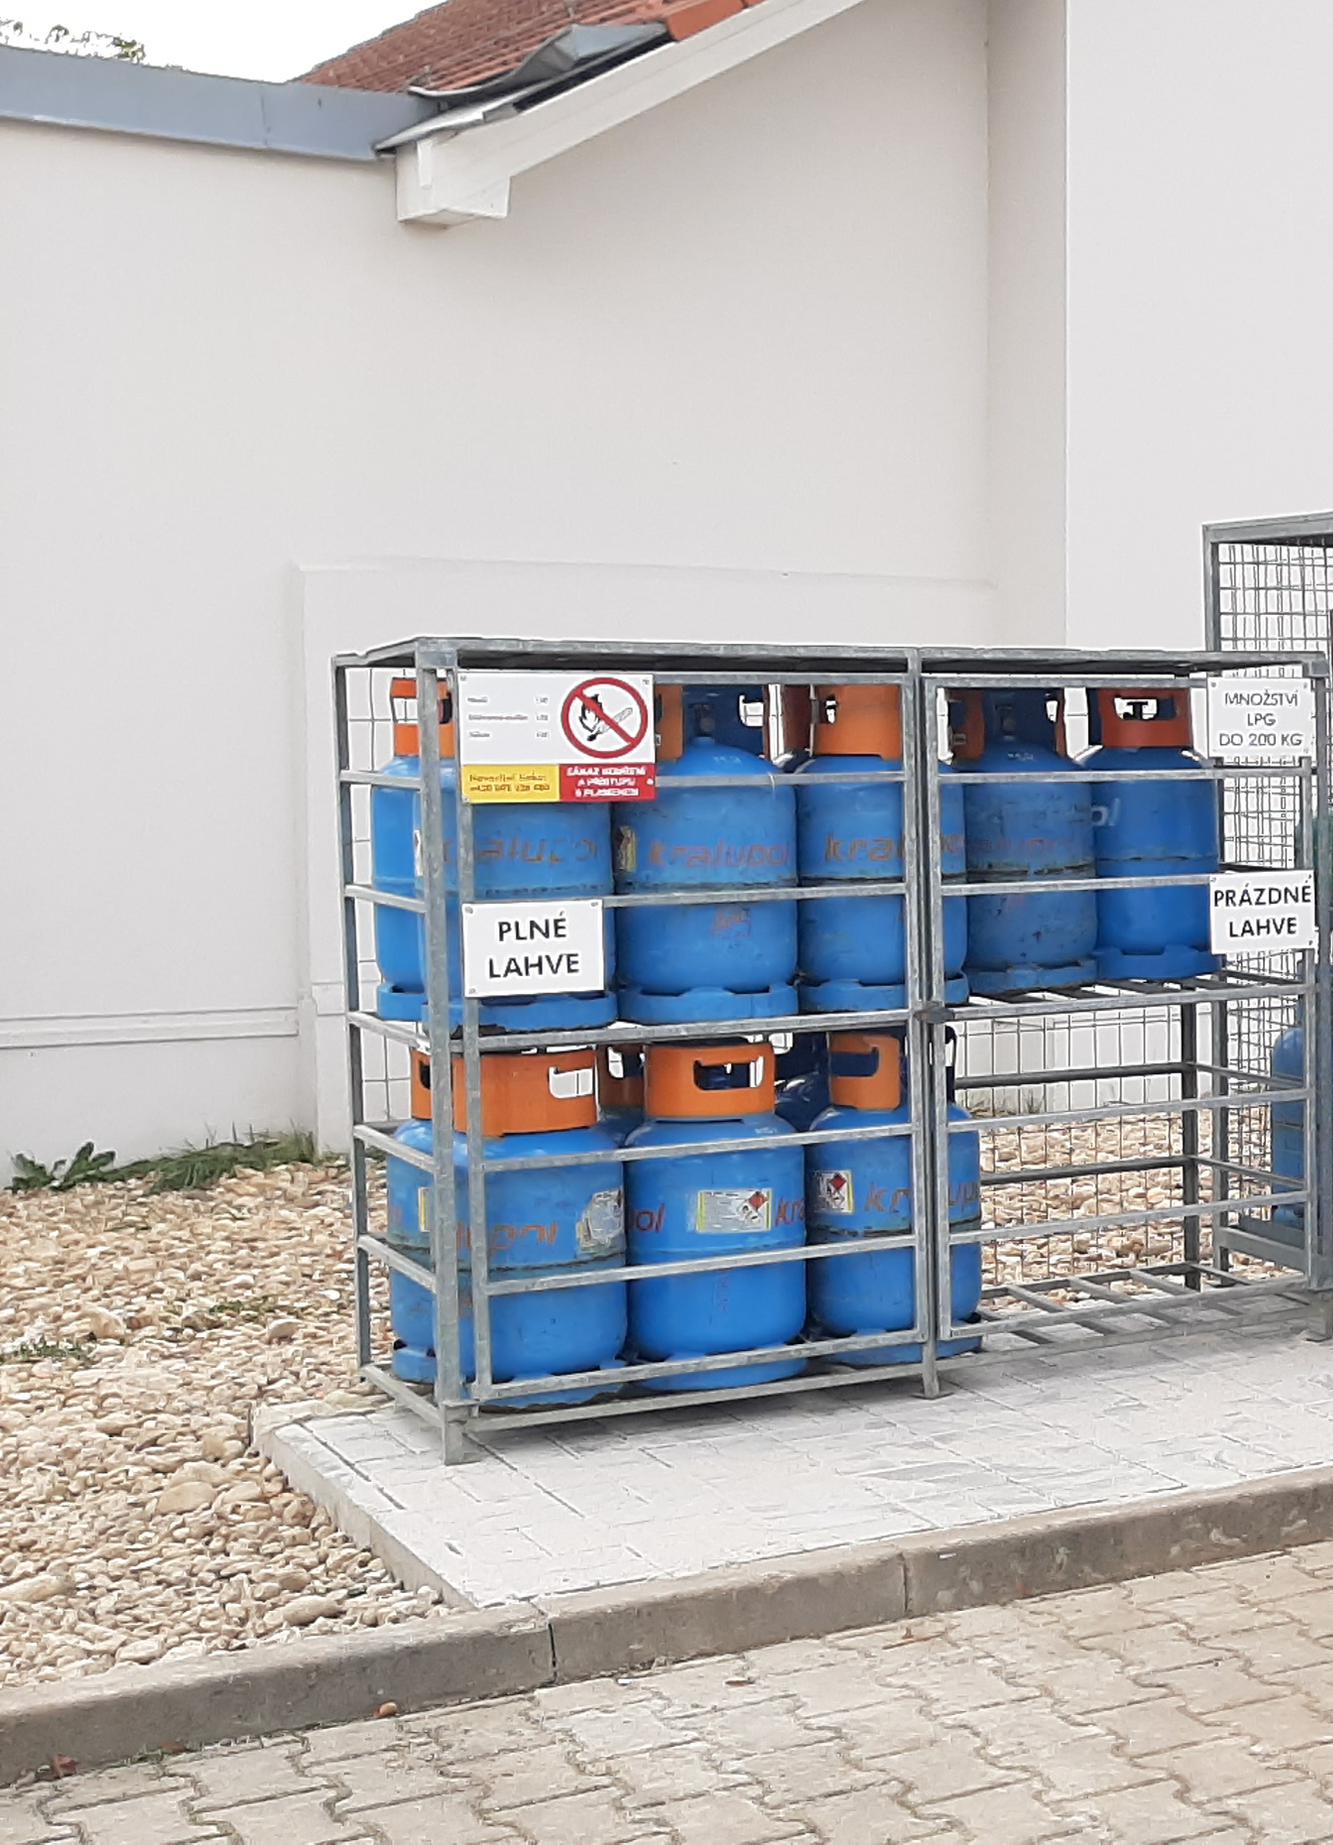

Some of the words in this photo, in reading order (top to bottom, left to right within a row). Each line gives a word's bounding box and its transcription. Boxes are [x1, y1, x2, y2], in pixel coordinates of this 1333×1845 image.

[1224, 689, 1299, 707] MNOŽSTVÍ
[1247, 712, 1277, 727] LPG
[1219, 733, 1243, 747] DO
[1248, 733, 1277, 747] 200
[1281, 733, 1303, 747] KG
[1214, 880, 1312, 907] PRÁZDNÉ
[498, 911, 567, 942] PLNÉ
[1229, 917, 1297, 938] LAHVE
[489, 953, 579, 978] LAHVE
